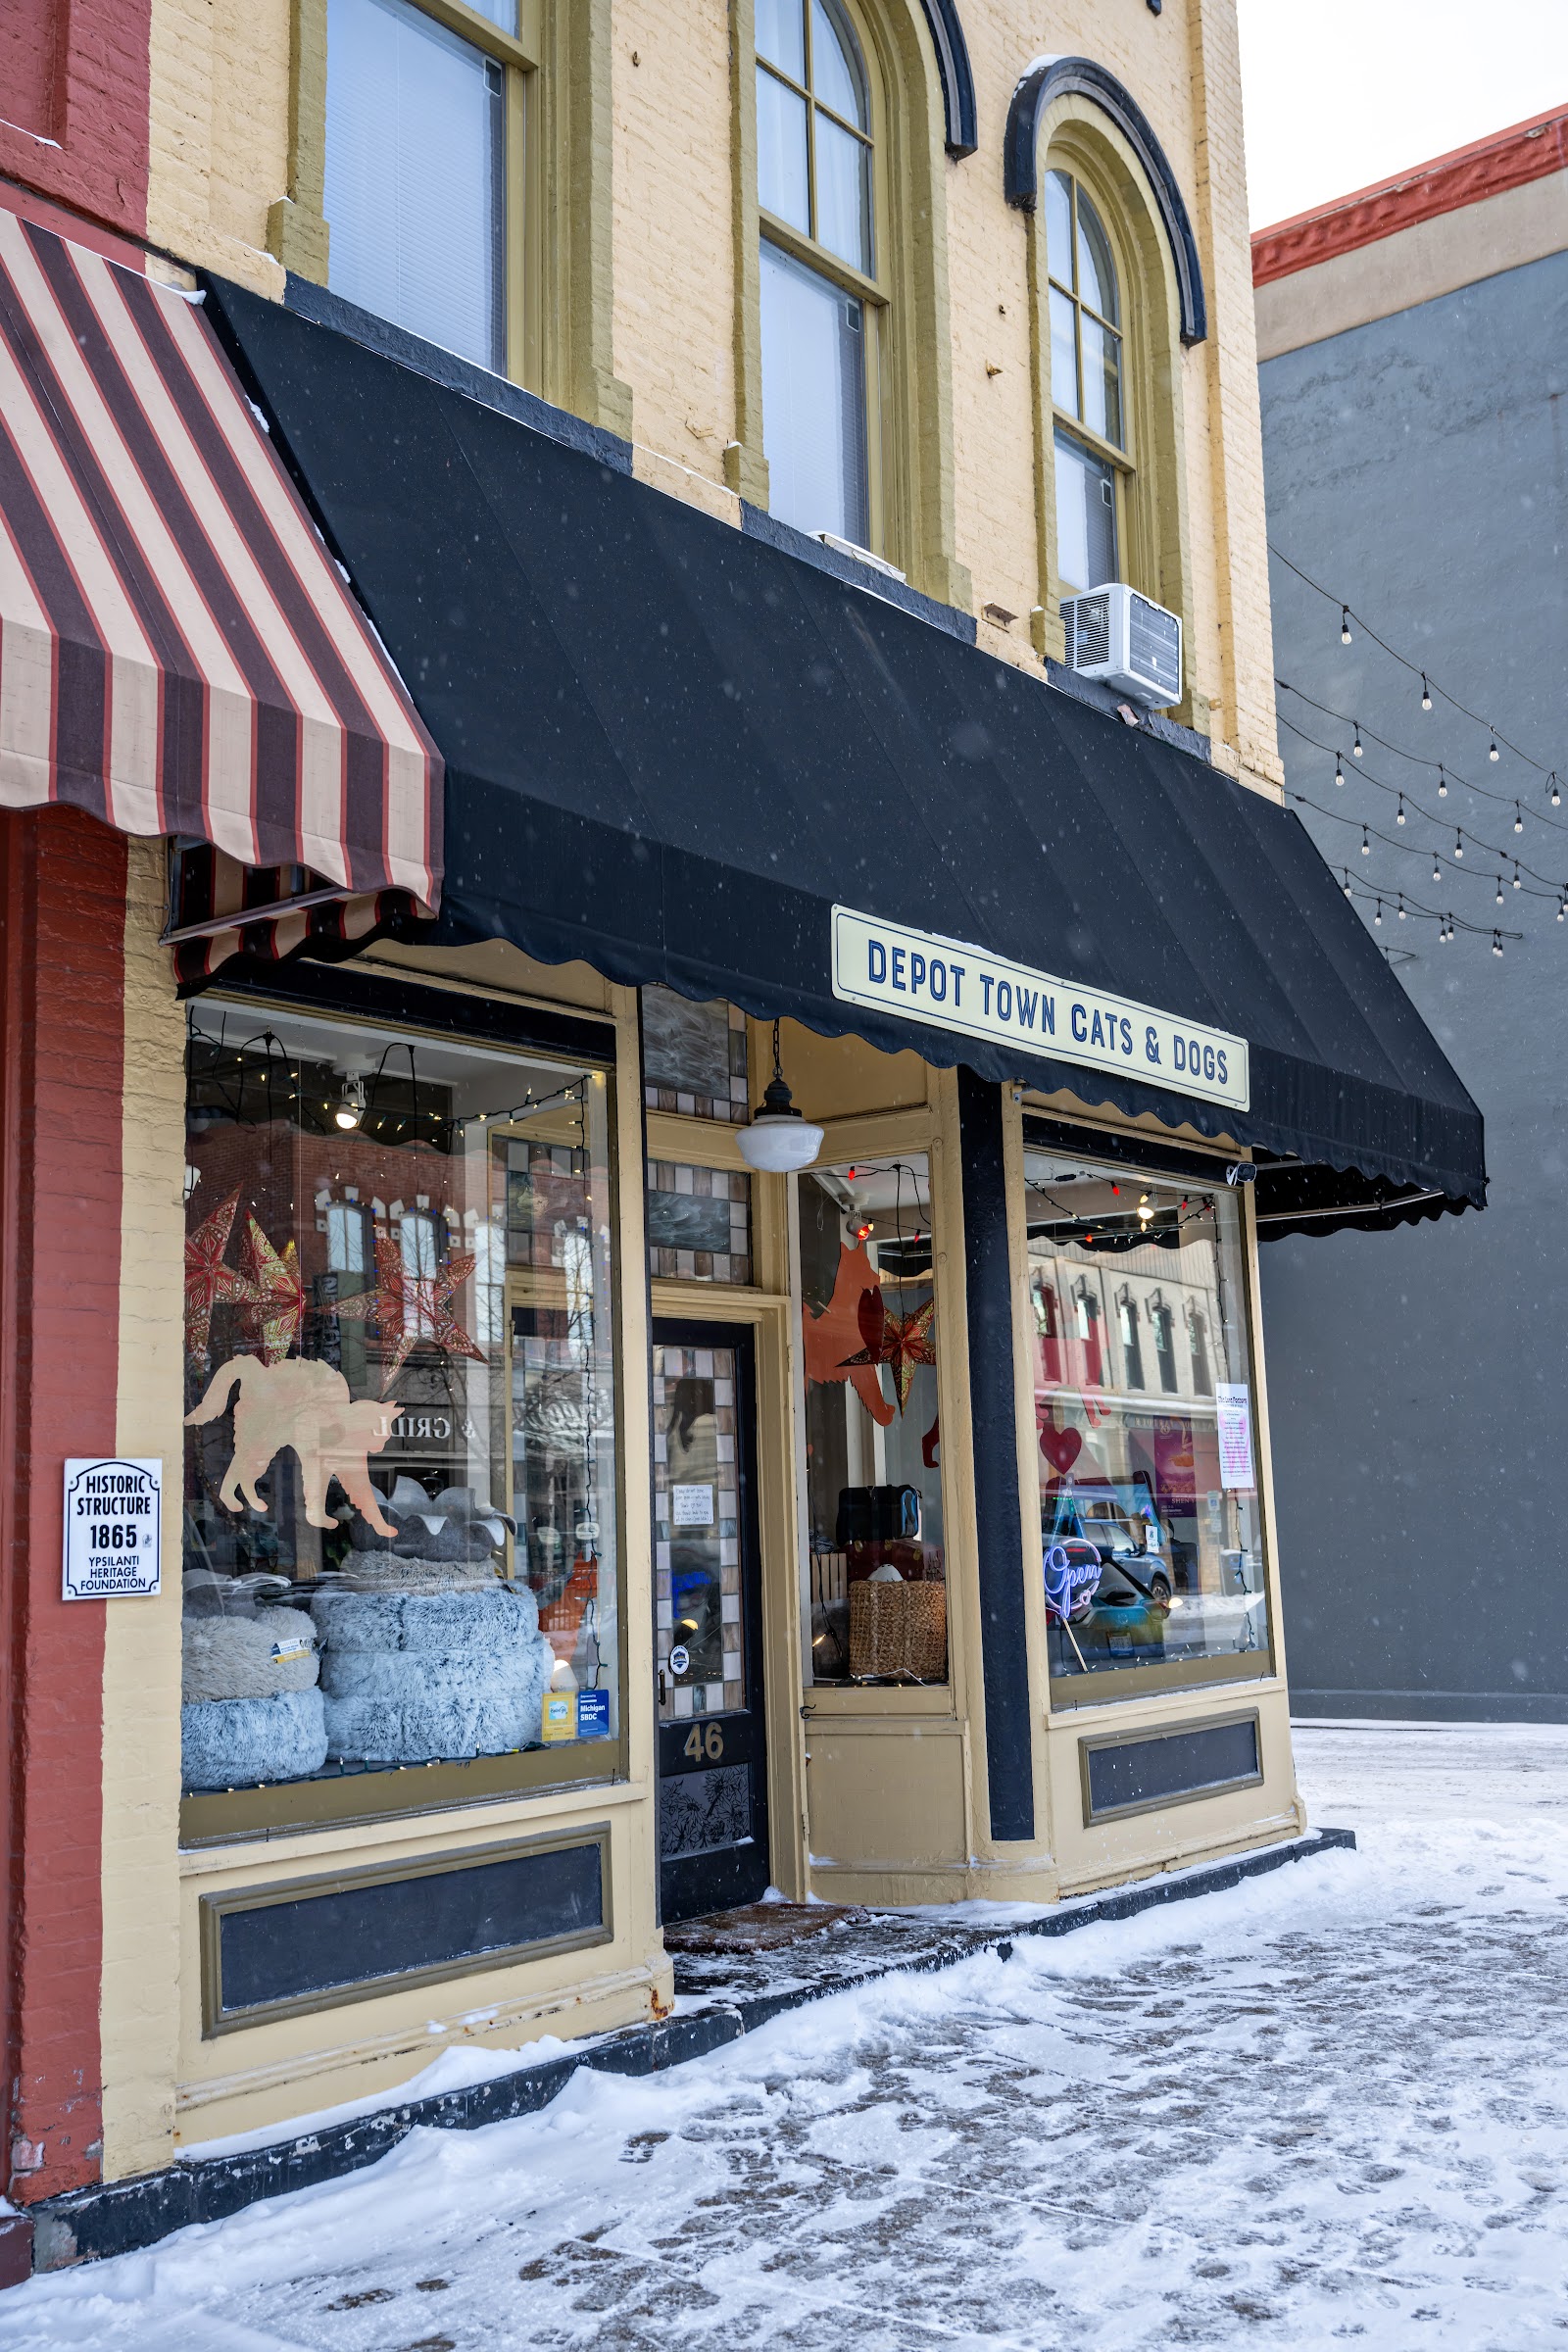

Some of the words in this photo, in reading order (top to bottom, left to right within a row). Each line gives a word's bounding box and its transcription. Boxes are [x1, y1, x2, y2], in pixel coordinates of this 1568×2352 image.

[868, 939, 965, 1006] DEPOT
[981, 974, 1055, 1035] TOWN
[1071, 1004, 1133, 1055] CATS
[1146, 1026, 1162, 1065] &
[1173, 1034, 1228, 1085] DOGS
[86, 1475, 145, 1494] HISTORIC
[76, 1496, 151, 1516] STRUCTURE
[90, 1524, 137, 1548] 1865
[88, 1555, 139, 1567] YPSILANTI
[90, 1567, 137, 1579] HERITAGE
[1043, 1545, 1103, 1619] Open
[80, 1578, 146, 1591] FOUNDATION
[580, 1704, 606, 1713] Michigan
[684, 1722, 723, 1762] 46
